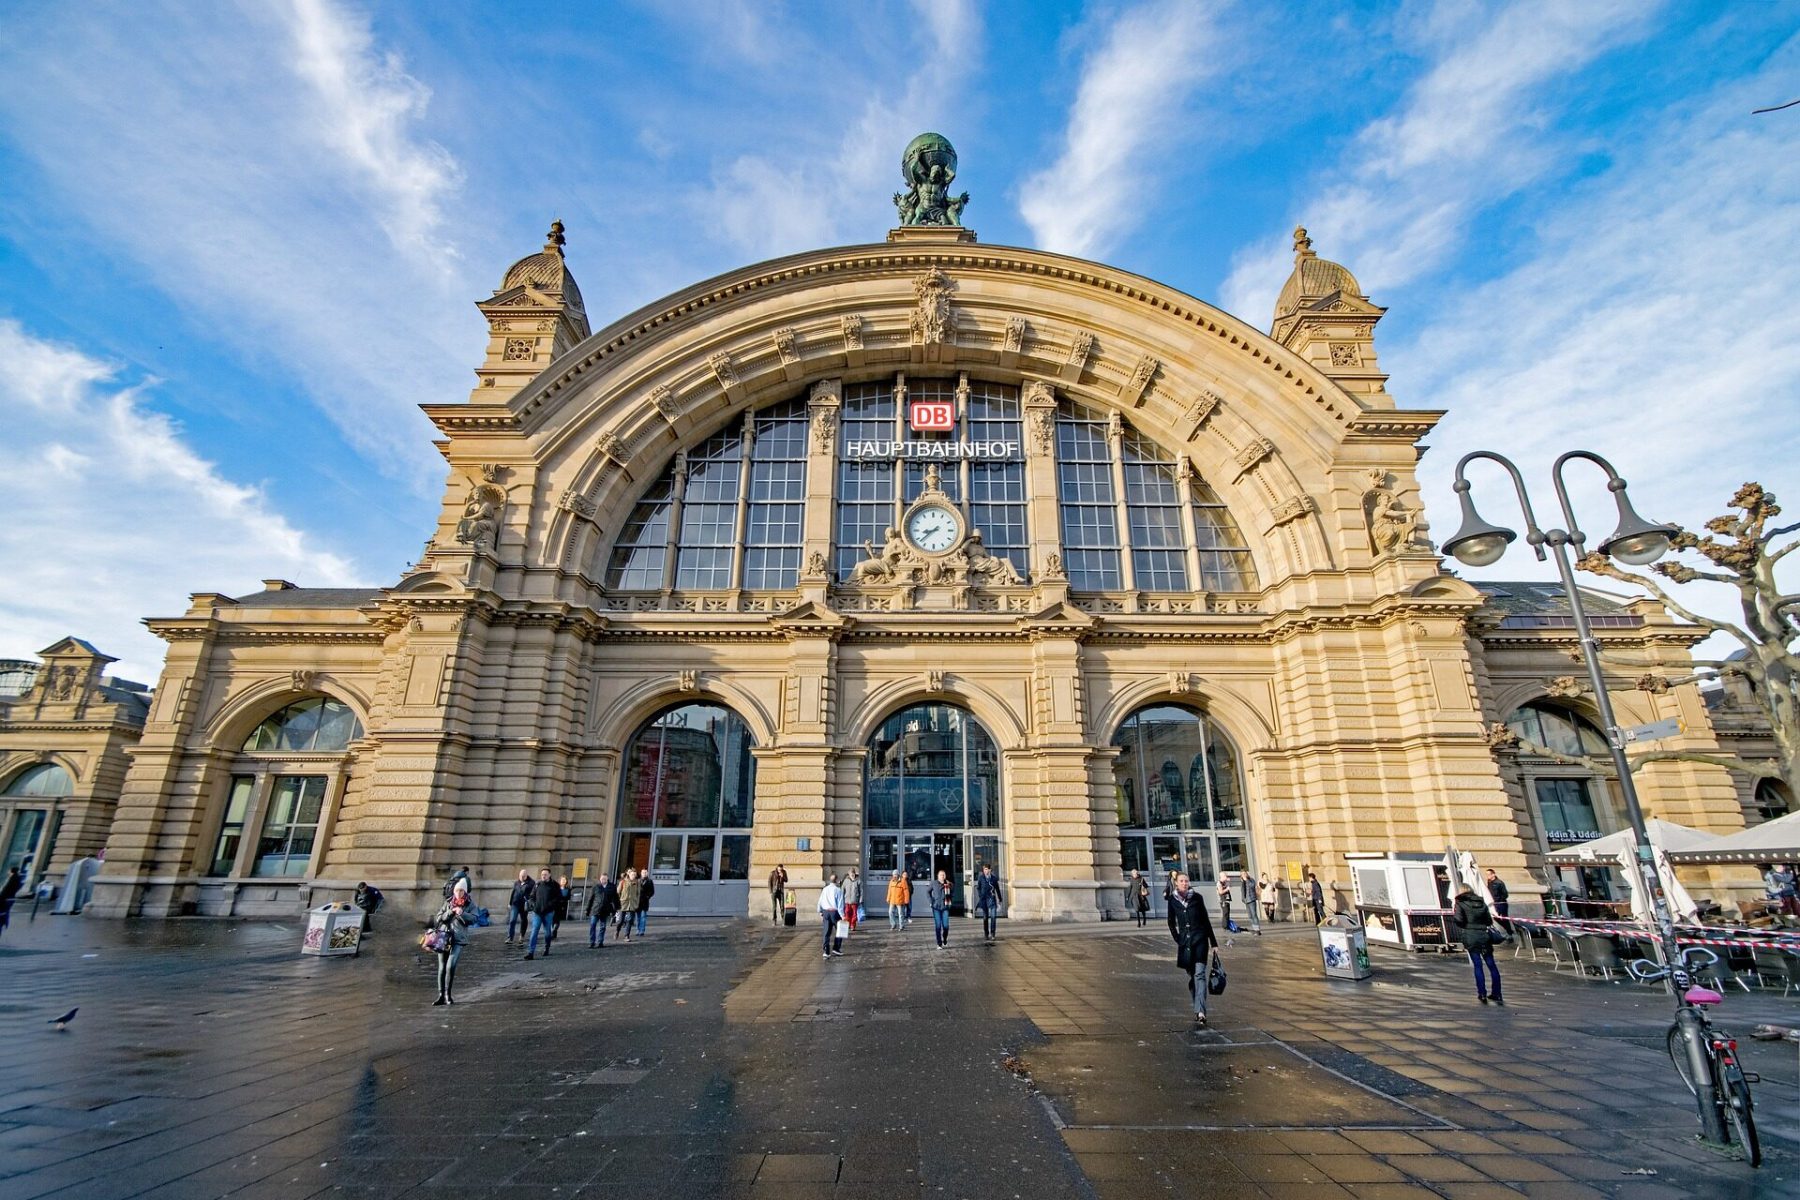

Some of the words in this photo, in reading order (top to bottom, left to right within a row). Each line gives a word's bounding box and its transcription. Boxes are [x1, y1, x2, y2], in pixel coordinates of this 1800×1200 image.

[916, 407, 948, 425] DB
[847, 441, 1018, 457] HAUPTBAHNHOF
[1577, 830, 1603, 838] Uddin
